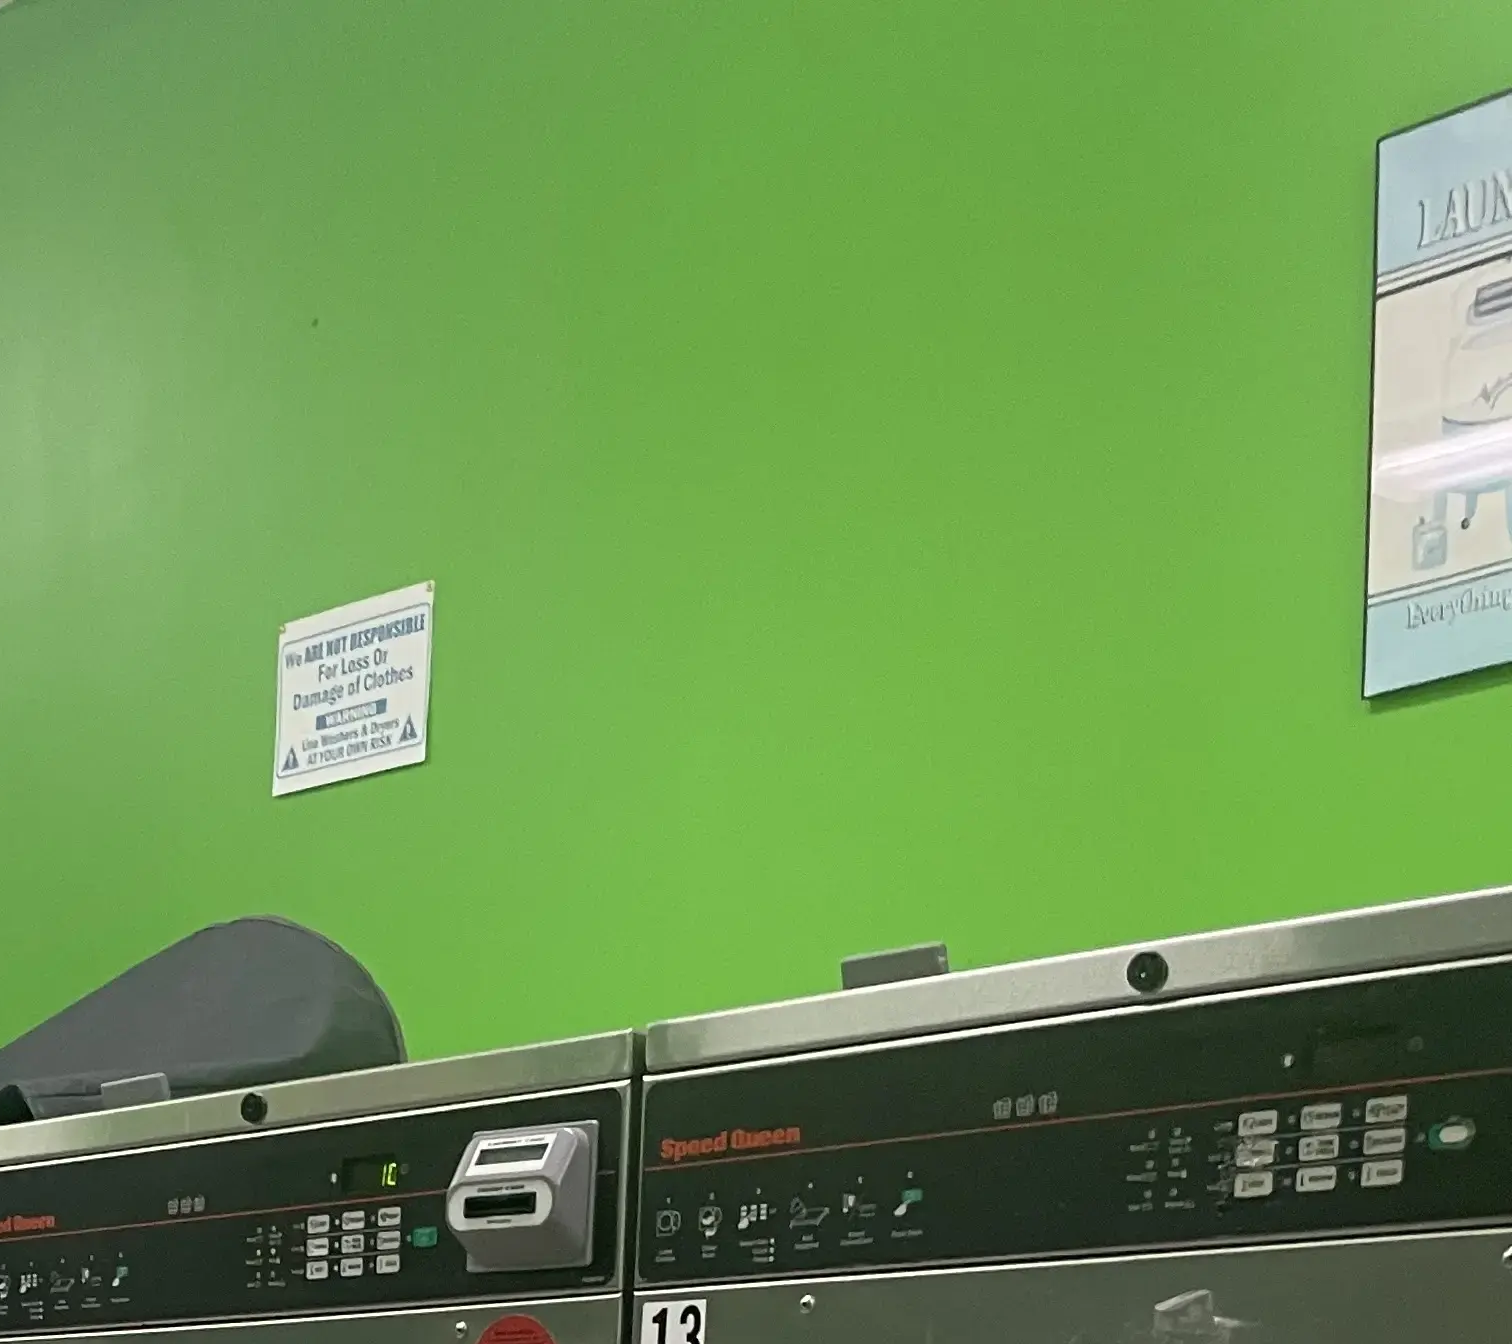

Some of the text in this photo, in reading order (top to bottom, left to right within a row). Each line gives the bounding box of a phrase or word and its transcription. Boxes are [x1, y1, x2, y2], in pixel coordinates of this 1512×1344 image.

[285, 613, 426, 669] We ARE NOT RESPONSIBLE
[318, 648, 388, 682] For Loss Or
[293, 666, 413, 711] Damage of Clothes
[661, 1126, 801, 1162] Speed Queen
